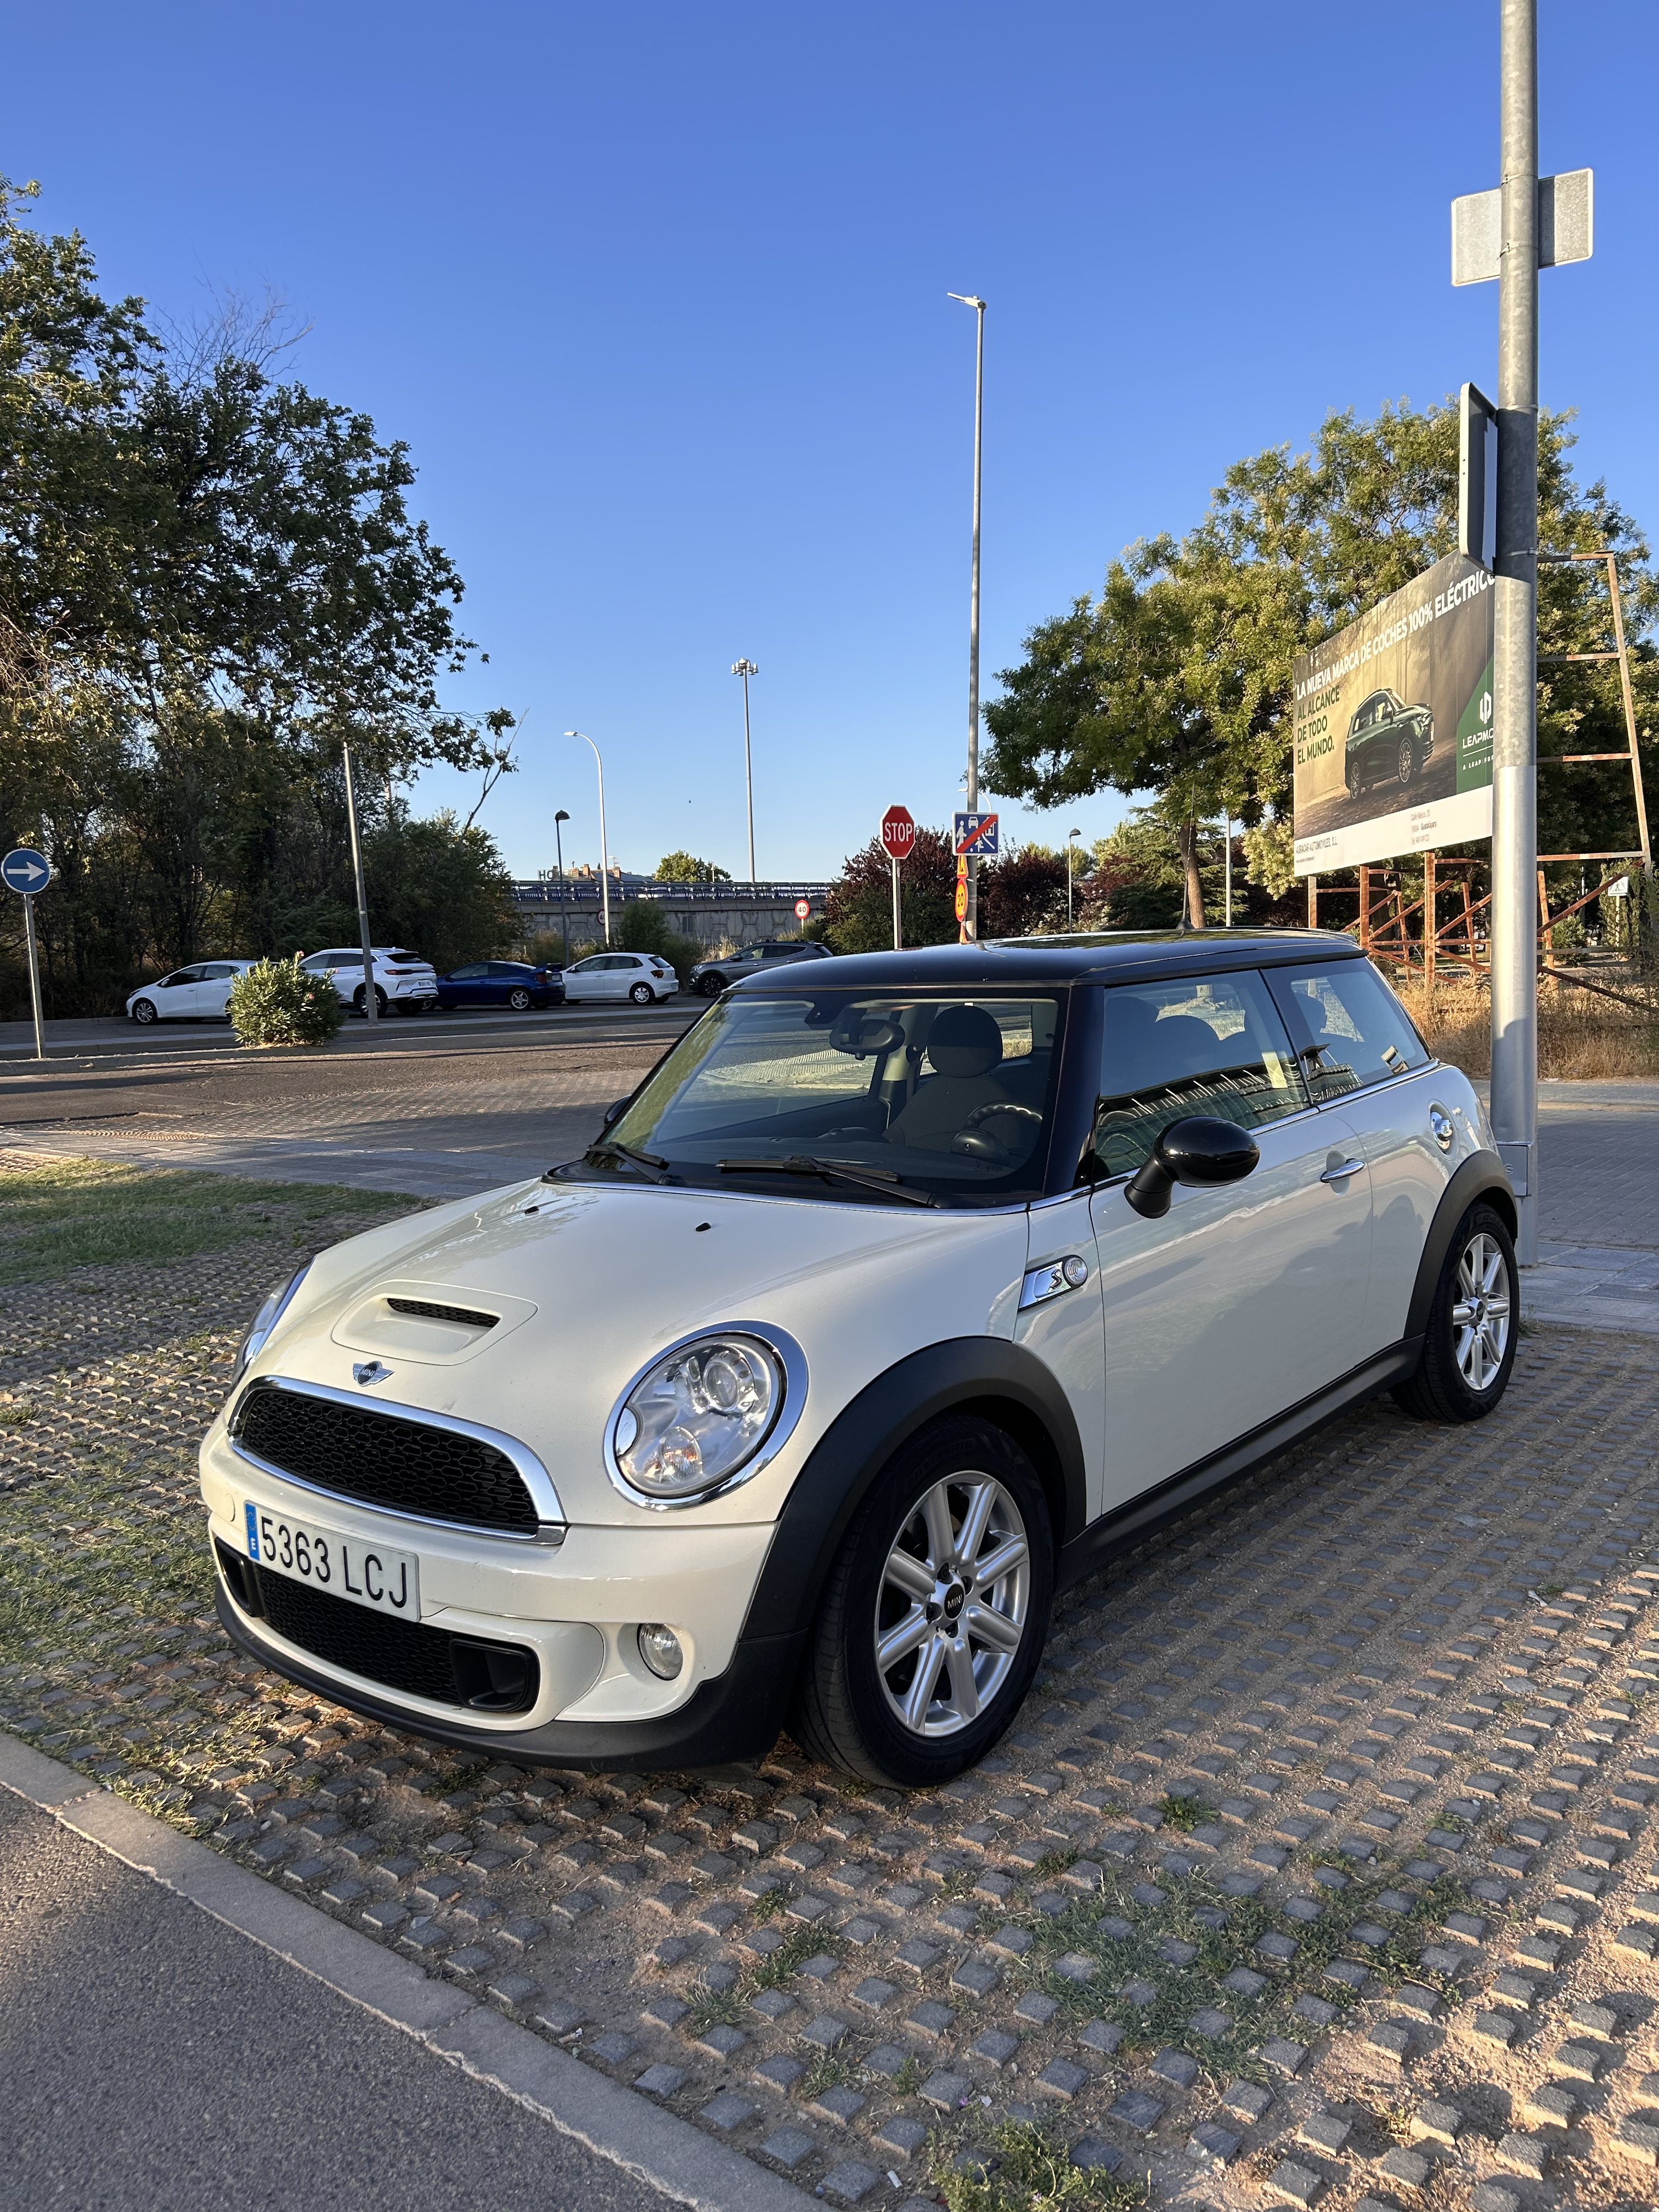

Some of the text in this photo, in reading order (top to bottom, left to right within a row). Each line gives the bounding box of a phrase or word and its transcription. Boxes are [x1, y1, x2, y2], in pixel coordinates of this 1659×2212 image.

[1296, 681, 1306, 701] LA
[1307, 667, 1331, 695] NUEVA
[1332, 650, 1359, 681] MARCA
[1360, 641, 1372, 664] DE
[1373, 617, 1408, 656] COCHES
[1409, 601, 1433, 634] 100%
[1297, 685, 1340, 722] AL ALCANCE
[1297, 715, 1328, 743] DE TODO
[1297, 735, 1334, 765] EL MUNDO.
[884, 822, 913, 842] STOP
[957, 893, 964, 907] 20
[360, 1368, 376, 1378] MINI
[251, 1537, 257, 1550] E
[261, 1516, 408, 1609] 5363 LCJ
[947, 1593, 963, 1610] MINI
